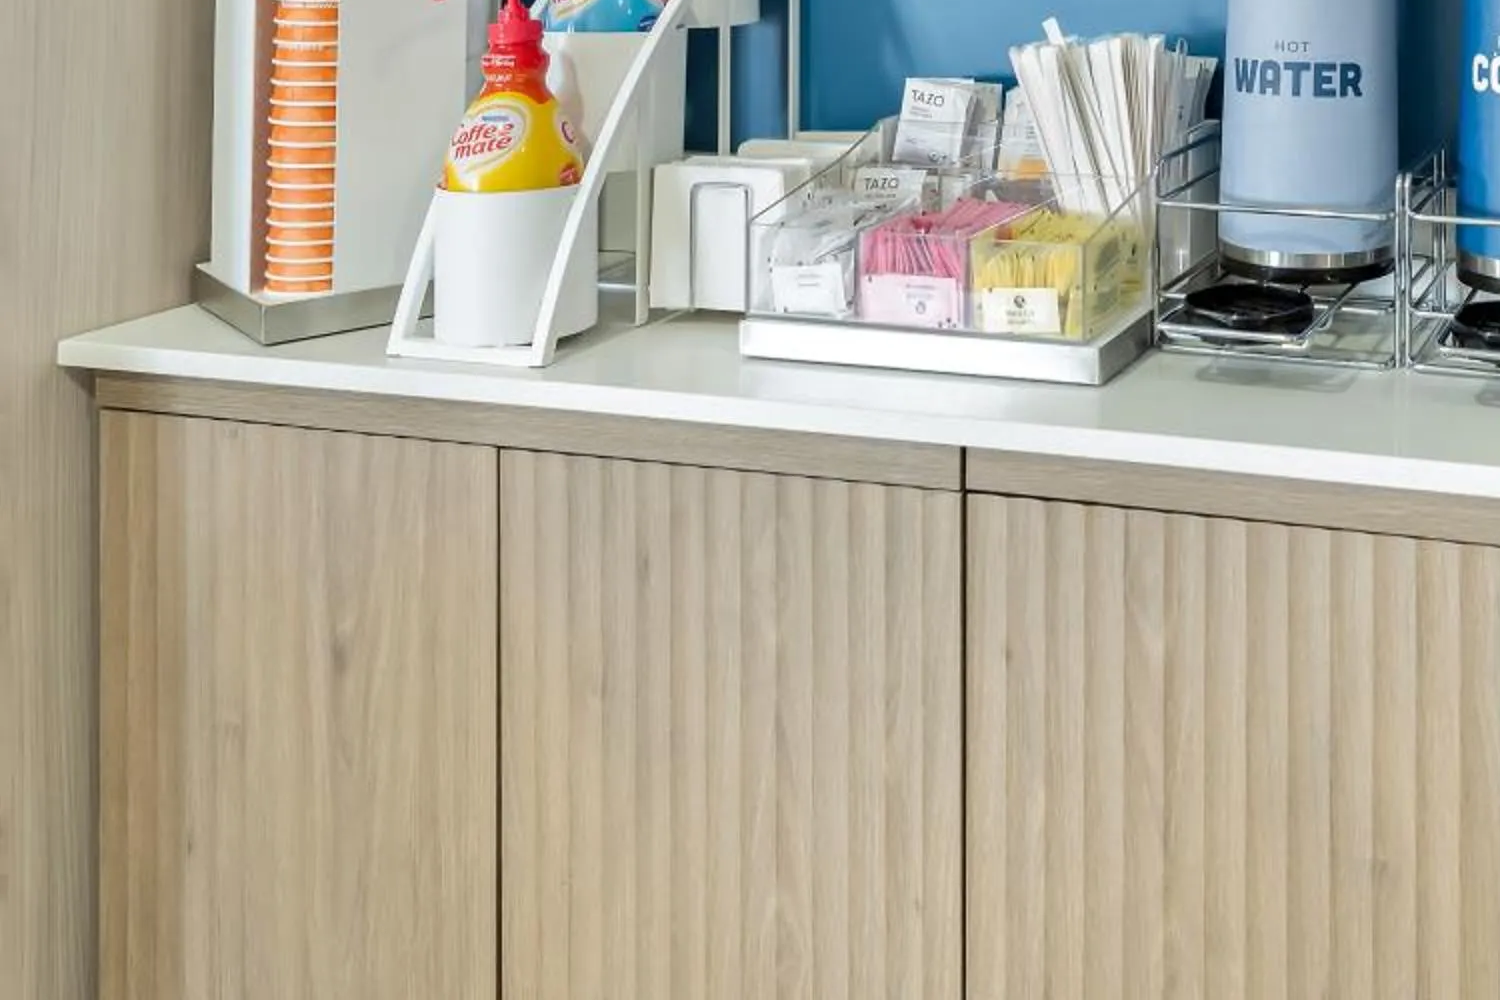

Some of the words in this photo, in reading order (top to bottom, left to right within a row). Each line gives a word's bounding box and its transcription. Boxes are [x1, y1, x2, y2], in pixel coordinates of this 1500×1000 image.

[1274, 40, 1311, 53] HOT
[1234, 57, 1364, 98] WATER
[911, 89, 945, 108] TAZO
[454, 136, 514, 161] mate
[864, 177, 900, 191] TAZO
